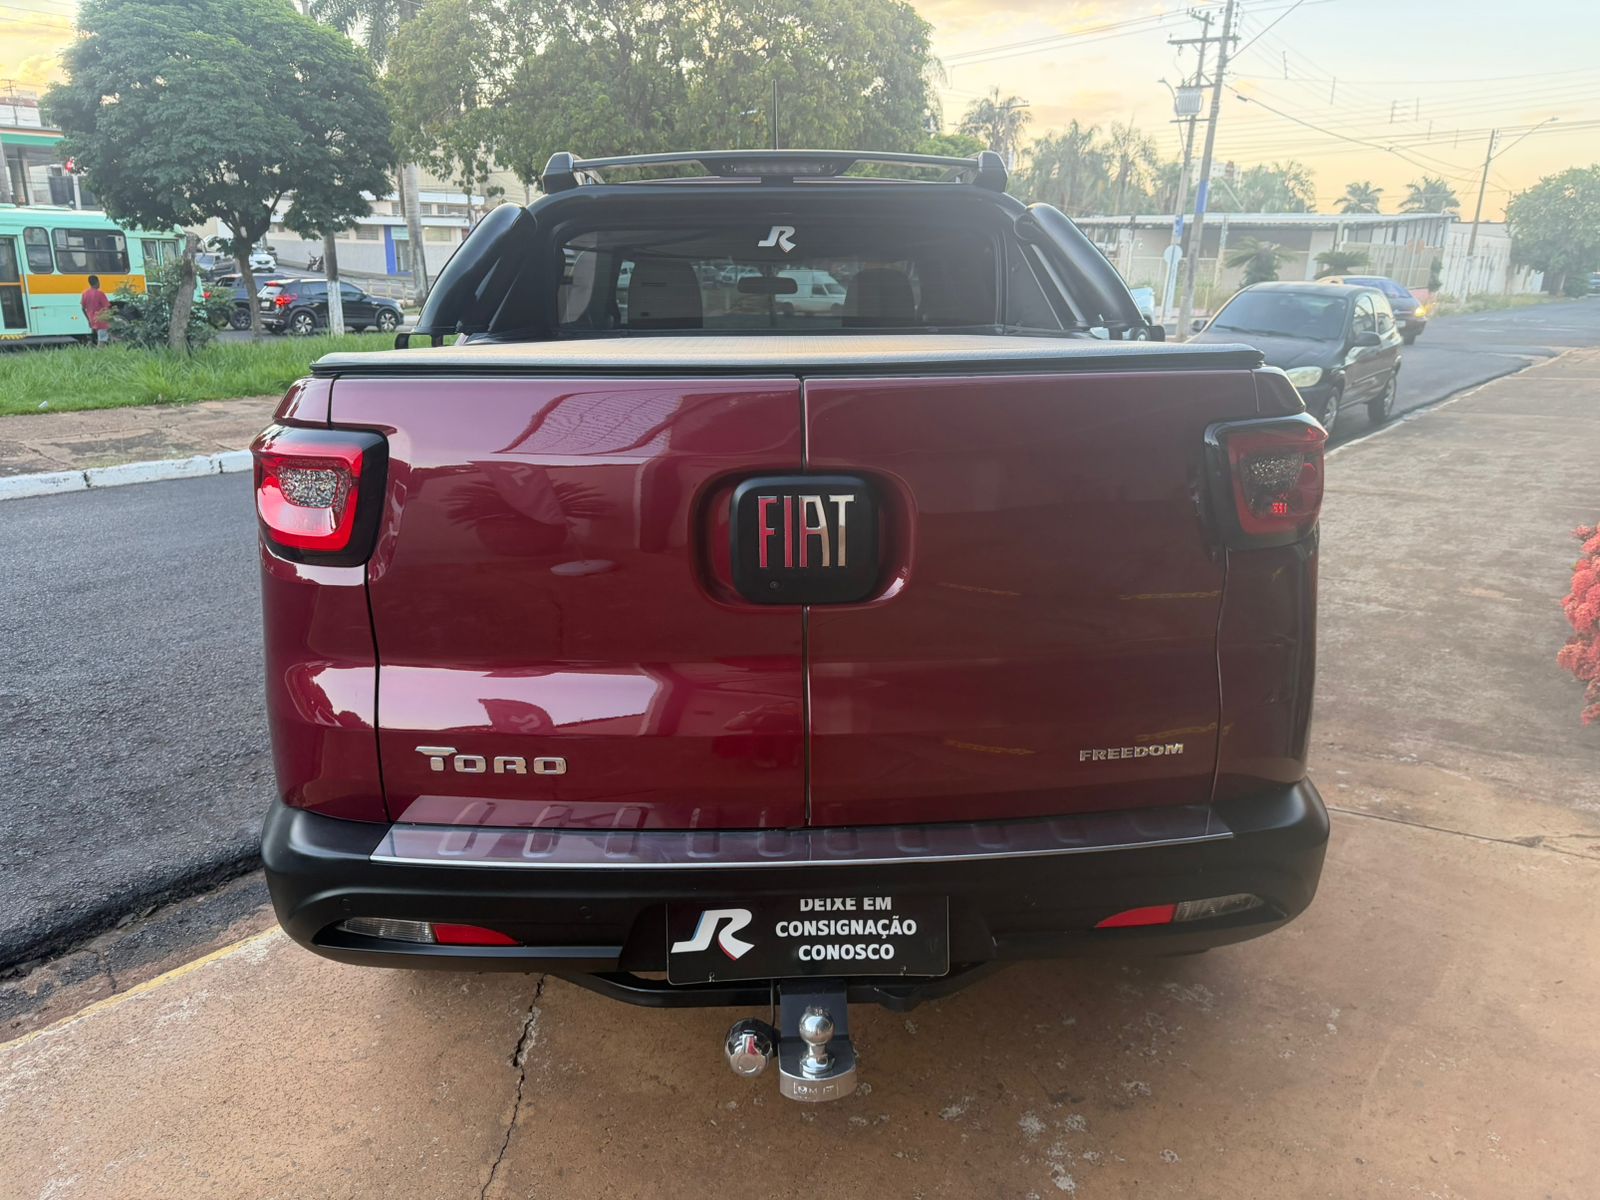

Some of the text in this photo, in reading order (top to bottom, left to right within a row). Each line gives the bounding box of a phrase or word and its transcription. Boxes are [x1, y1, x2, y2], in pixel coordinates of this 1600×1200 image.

[757, 494, 856, 568] FIAT
[415, 745, 567, 775] TORO
[1079, 743, 1184, 762] FREEDOM
[799, 896, 893, 912] DEIXE EM
[775, 915, 918, 939] CONSIGNAÇÃO
[798, 943, 895, 961] CONOSCO
